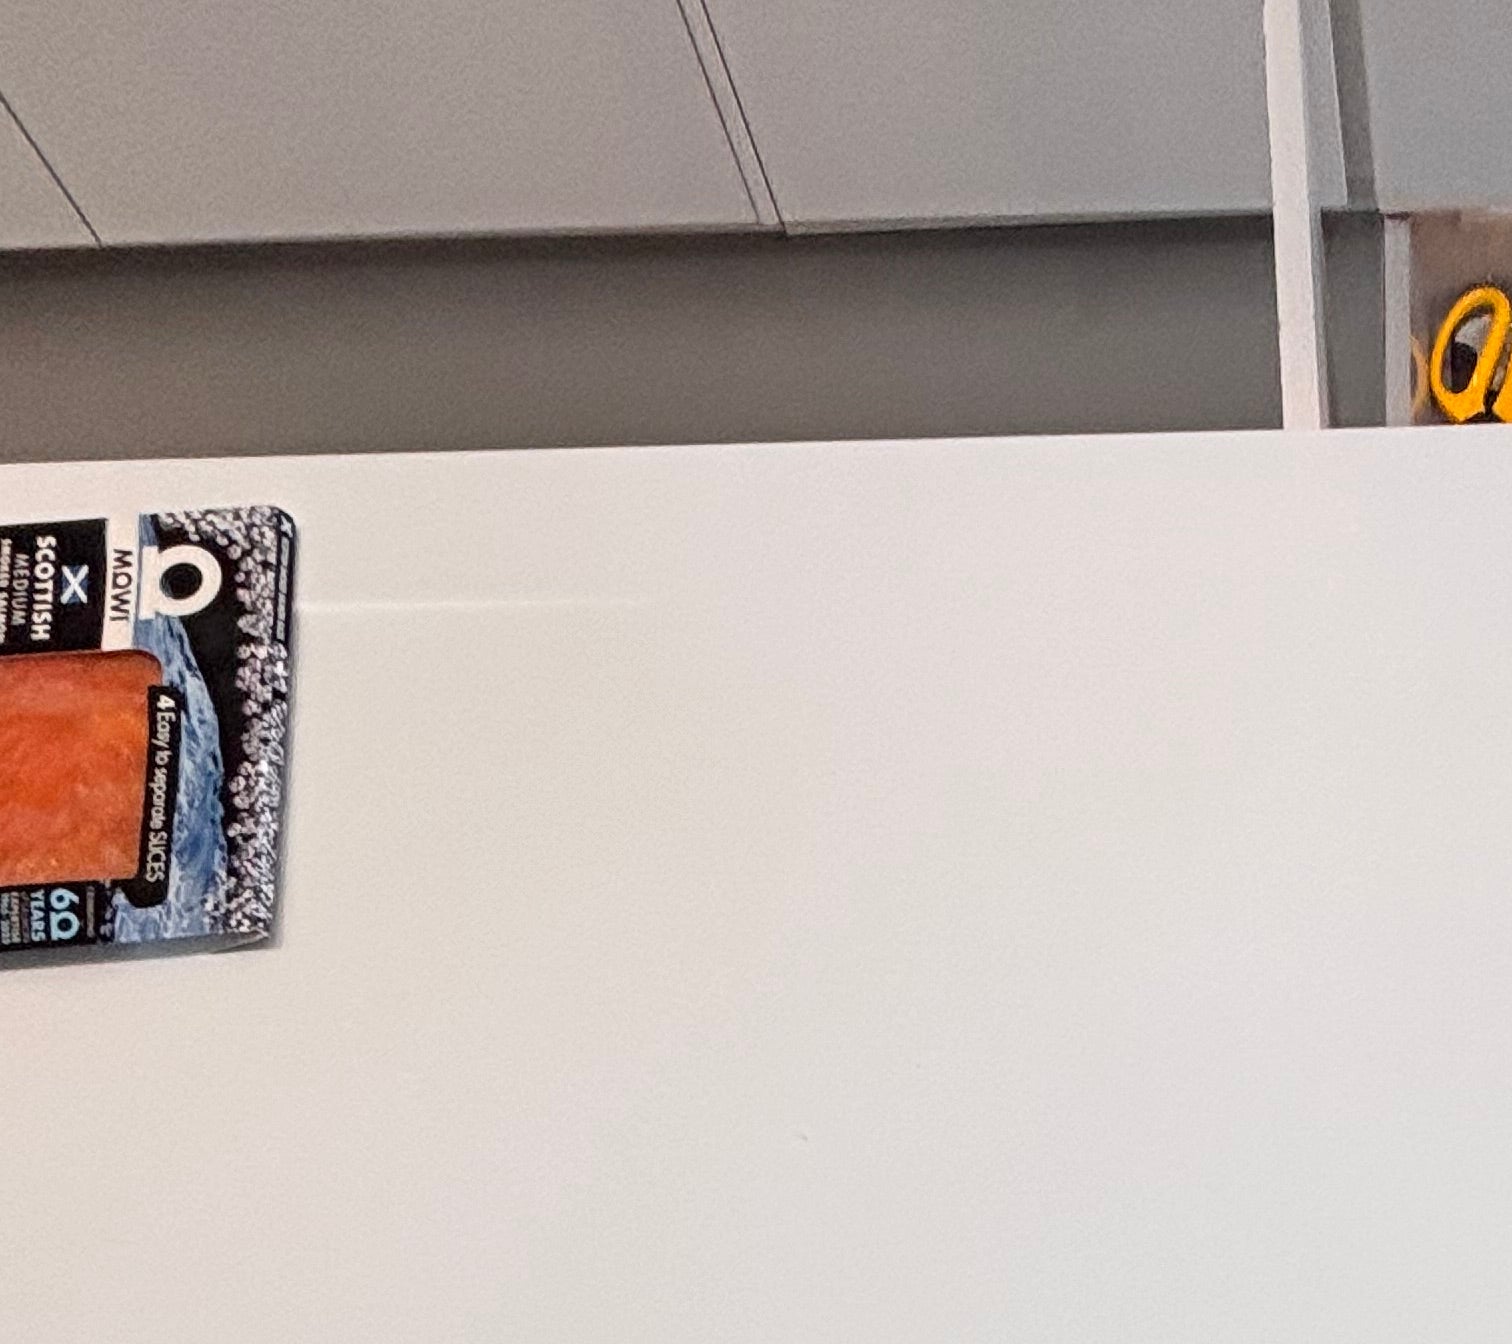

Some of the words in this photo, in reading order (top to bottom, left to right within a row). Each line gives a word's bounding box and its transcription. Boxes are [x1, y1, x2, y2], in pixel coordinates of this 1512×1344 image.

[11, 553, 30, 626] MEDIUM
[30, 535, 57, 640] SCOTTISH
[109, 548, 133, 621] MOWI
[156, 694, 176, 711] 4
[151, 711, 176, 749] Easy
[154, 750, 173, 766] to
[148, 767, 168, 831] separate
[145, 830, 168, 883] SLICES
[30, 888, 46, 942] YEARS
